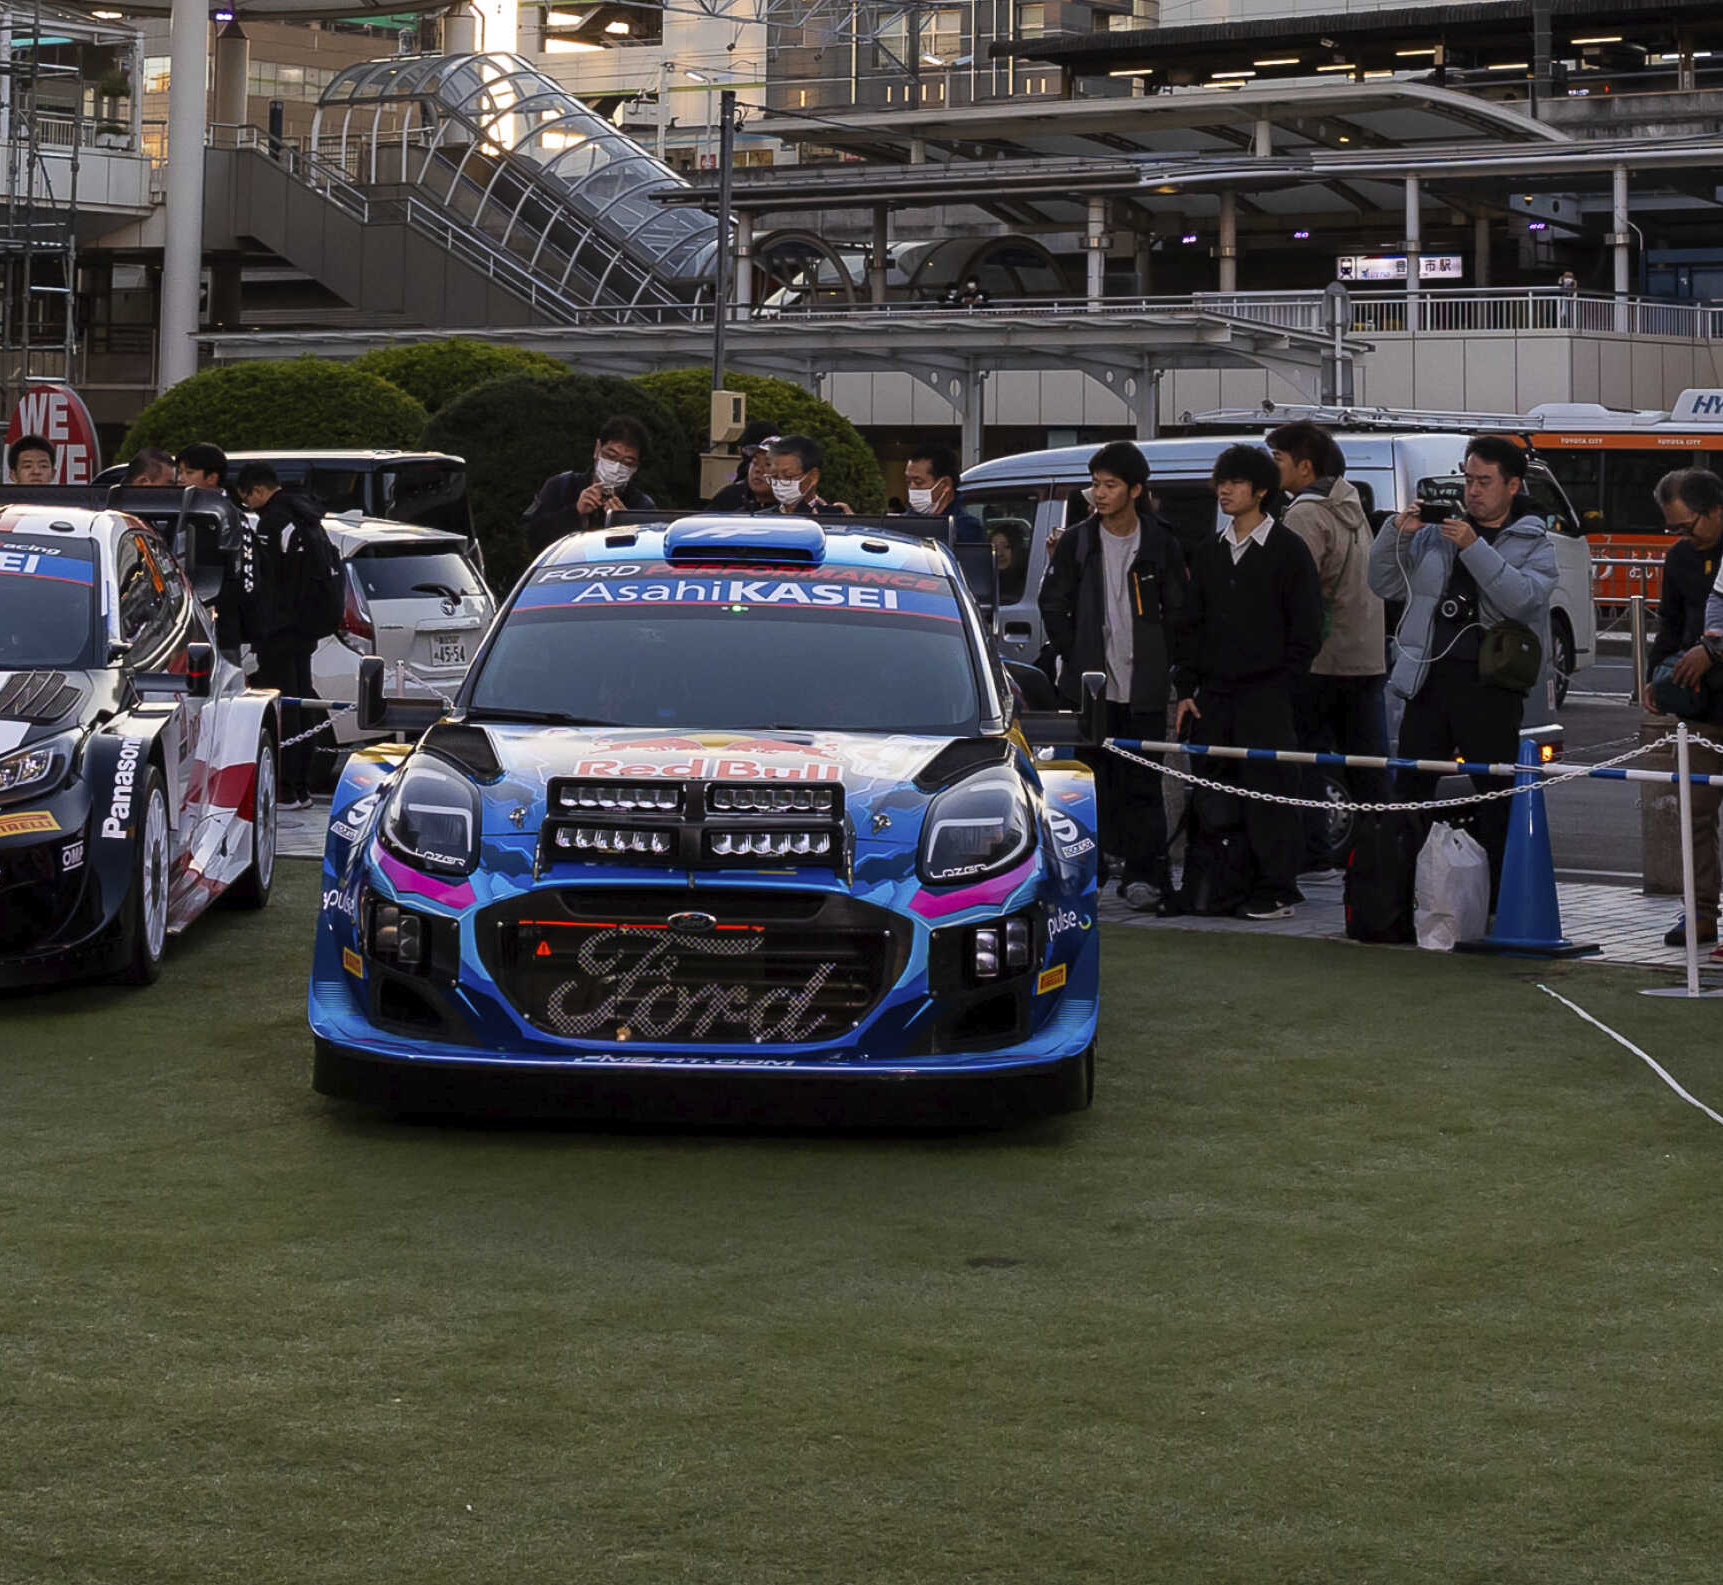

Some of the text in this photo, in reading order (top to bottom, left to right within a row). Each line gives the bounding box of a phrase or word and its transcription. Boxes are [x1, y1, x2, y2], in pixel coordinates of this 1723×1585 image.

[18, 393, 69, 440] WE
[2, 444, 88, 485] LVE
[537, 563, 946, 591] FORD PERFORMANCE
[572, 581, 899, 609] AsahiKASEI
[576, 758, 840, 781] Red Bull
[62, 846, 84, 866] OMP
[1047, 907, 1077, 942] pulse
[547, 925, 836, 1041] Ford
